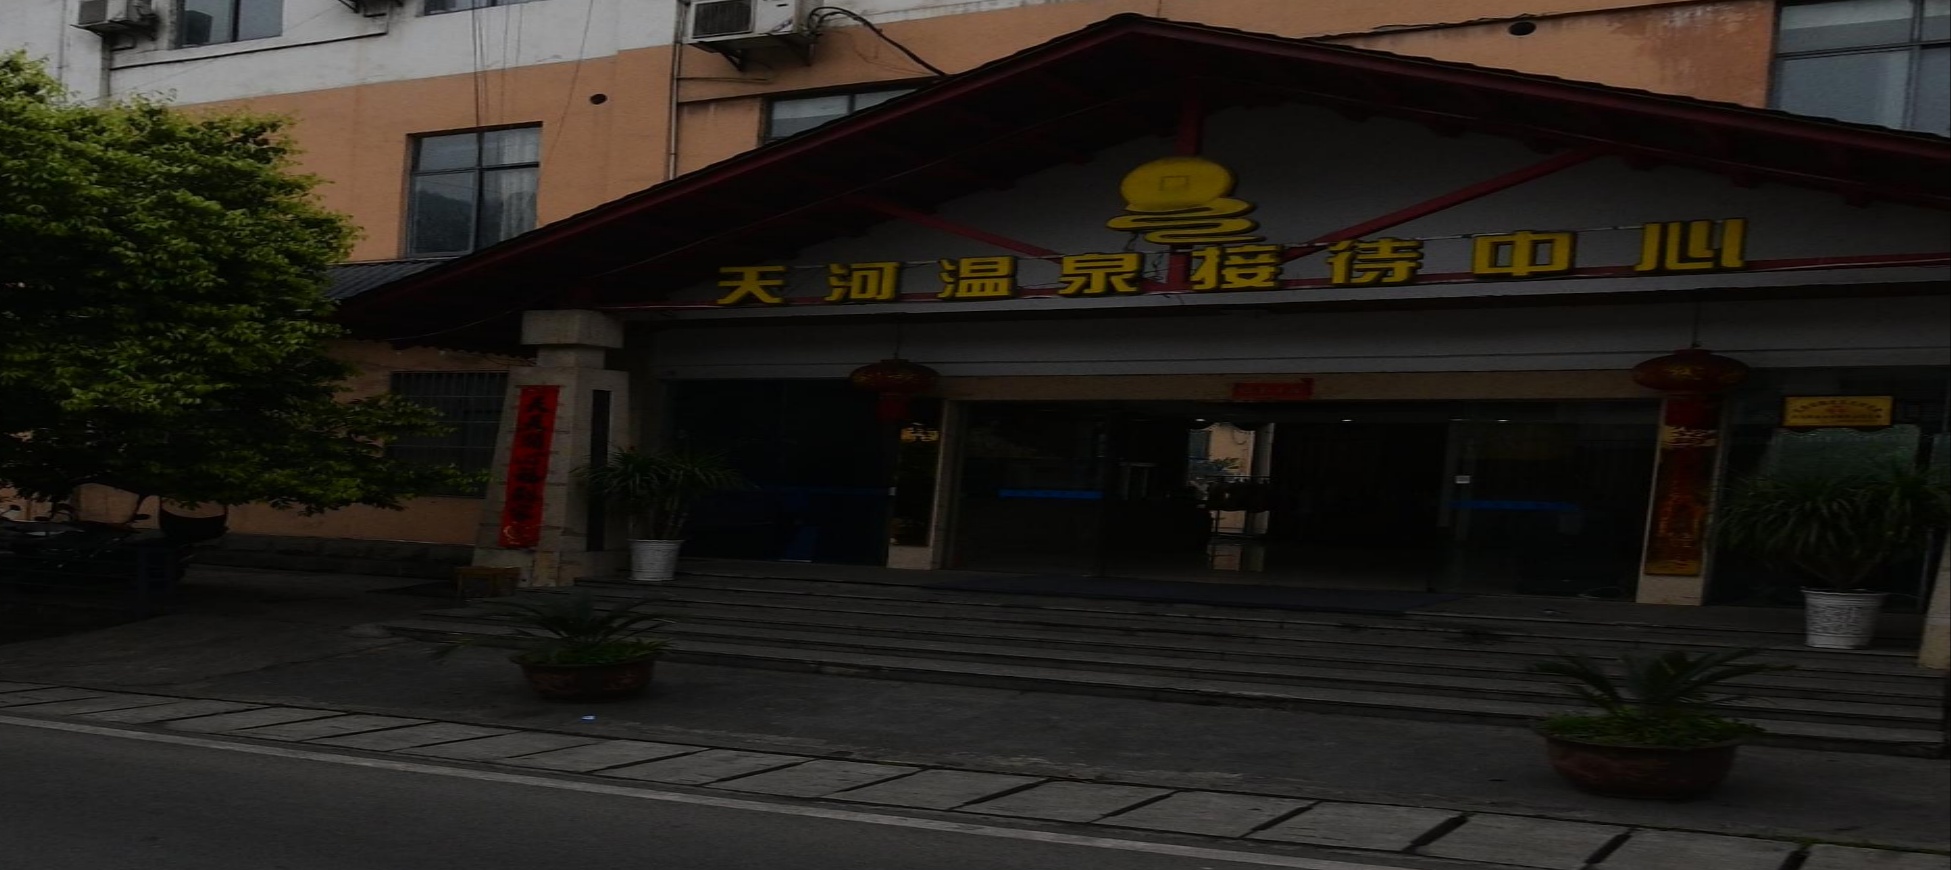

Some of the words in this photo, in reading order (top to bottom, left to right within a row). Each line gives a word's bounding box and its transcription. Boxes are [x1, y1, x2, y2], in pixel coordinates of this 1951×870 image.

[717, 218, 1747, 305] 天河温泉接待中心
